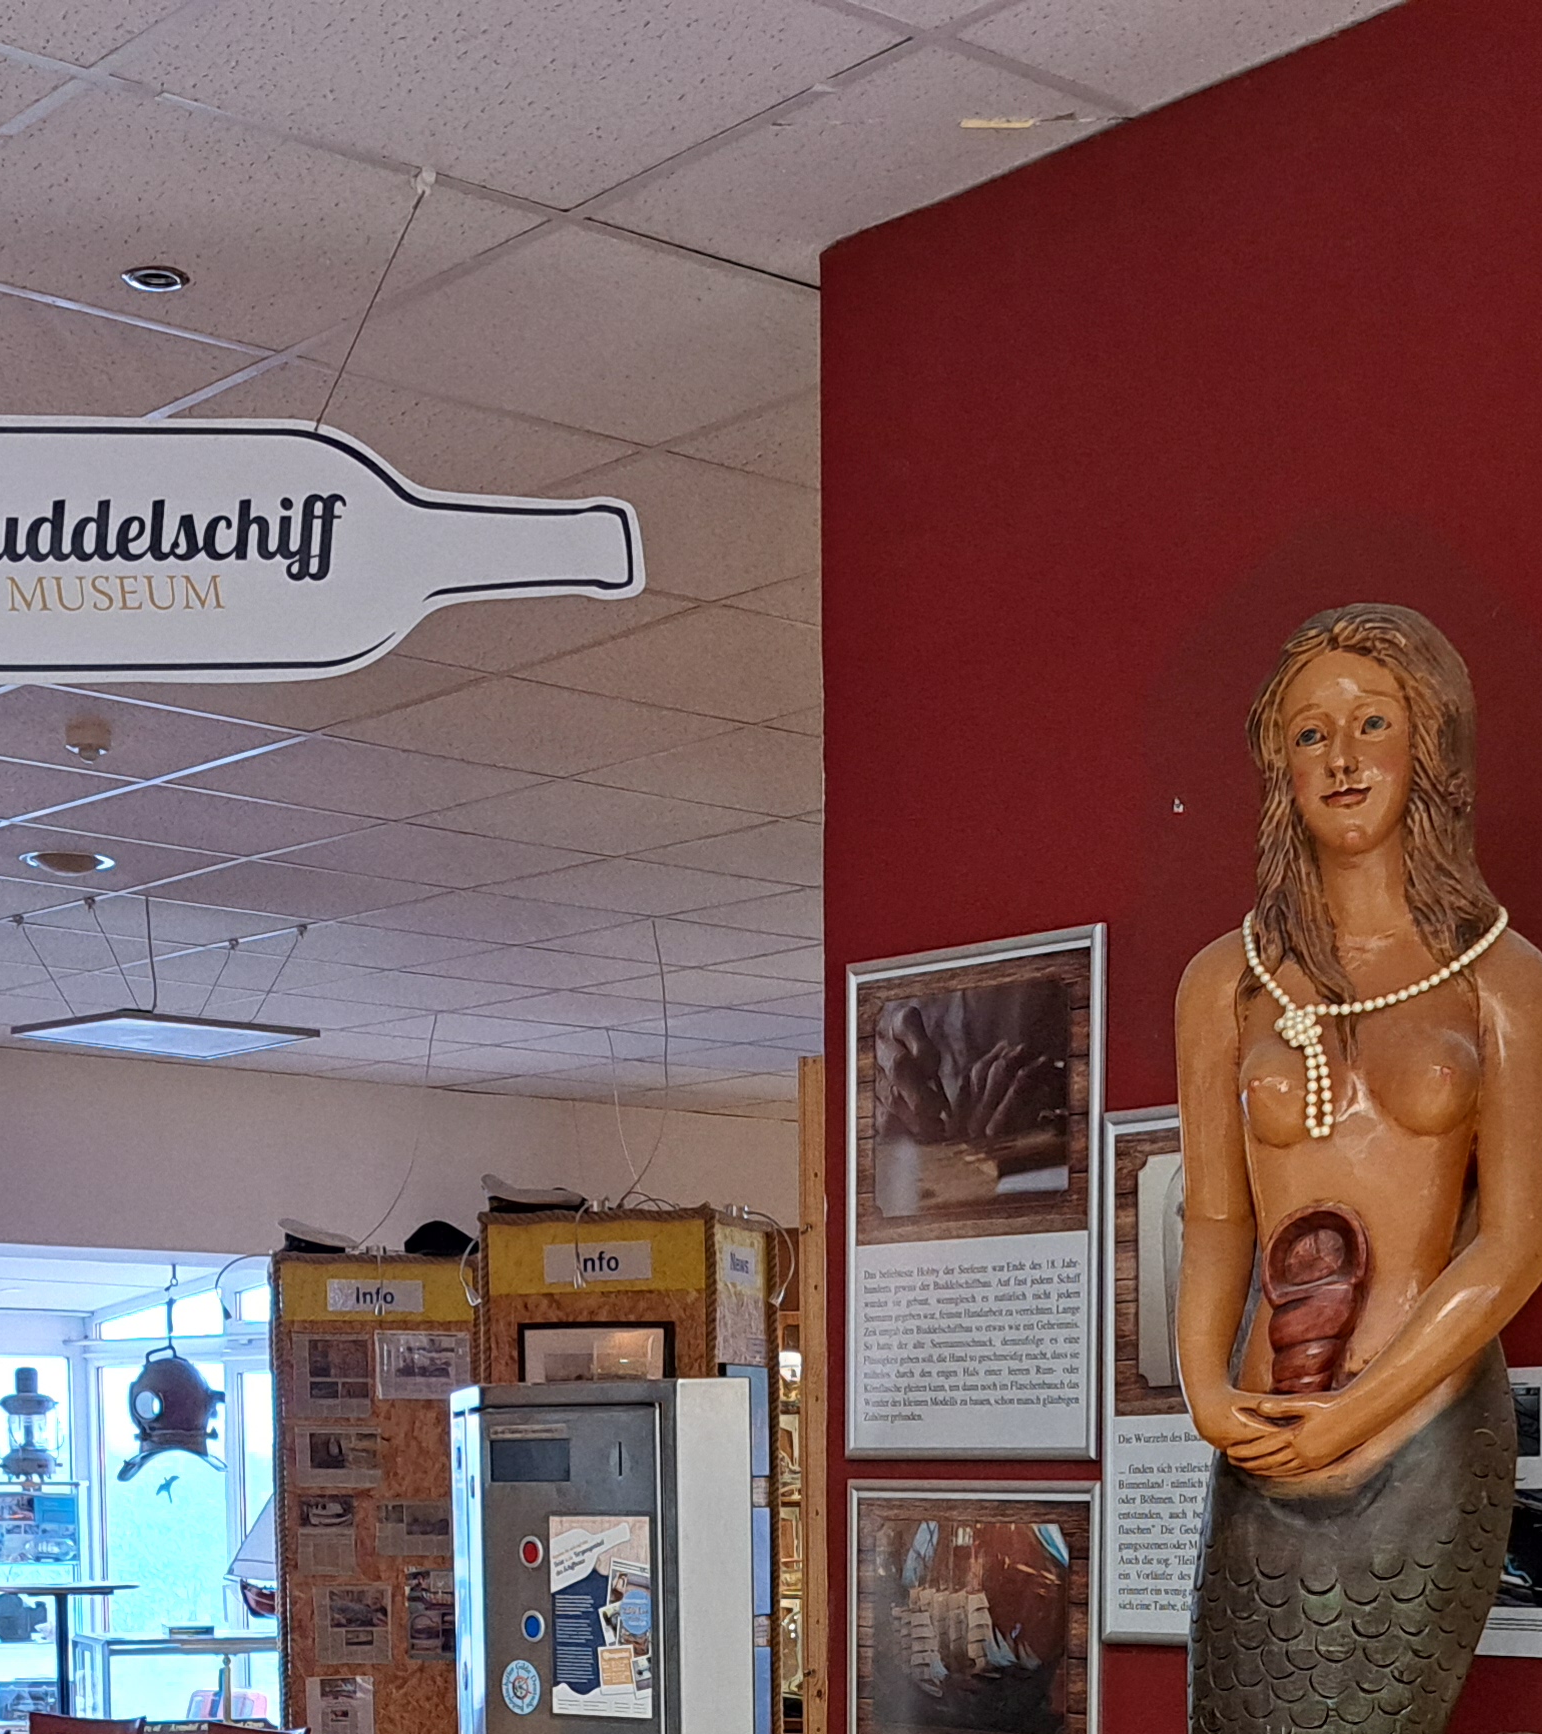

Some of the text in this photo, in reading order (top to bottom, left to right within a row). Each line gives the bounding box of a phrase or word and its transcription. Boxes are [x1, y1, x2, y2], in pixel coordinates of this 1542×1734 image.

[6, 574, 225, 612] MUSEUM
[576, 1252, 620, 1274] nfo
[729, 1252, 749, 1274] News
[1007, 1261, 1026, 1272] Ende
[1057, 1273, 1081, 1284] Schiff
[355, 1286, 395, 1306] Info
[1118, 1434, 1133, 1445] Die
[1134, 1432, 1168, 1444] Wurzeln
[1169, 1432, 1182, 1443] des
[1128, 1464, 1154, 1474] finden
[1156, 1463, 1173, 1473] sich
[1118, 1494, 1137, 1505] oder
[1179, 1493, 1198, 1504] Dort
[1168, 1508, 1187, 1519] auch
[1160, 1524, 1175, 1535] Die
[1169, 1540, 1187, 1550] oder
[1118, 1555, 1140, 1565] Auch
[1141, 1555, 1154, 1565] die
[1118, 1570, 1130, 1580] ein
[1177, 1570, 1192, 1580] des
[1150, 1586, 1162, 1596] ein
[1163, 1586, 1187, 1599] wenig
